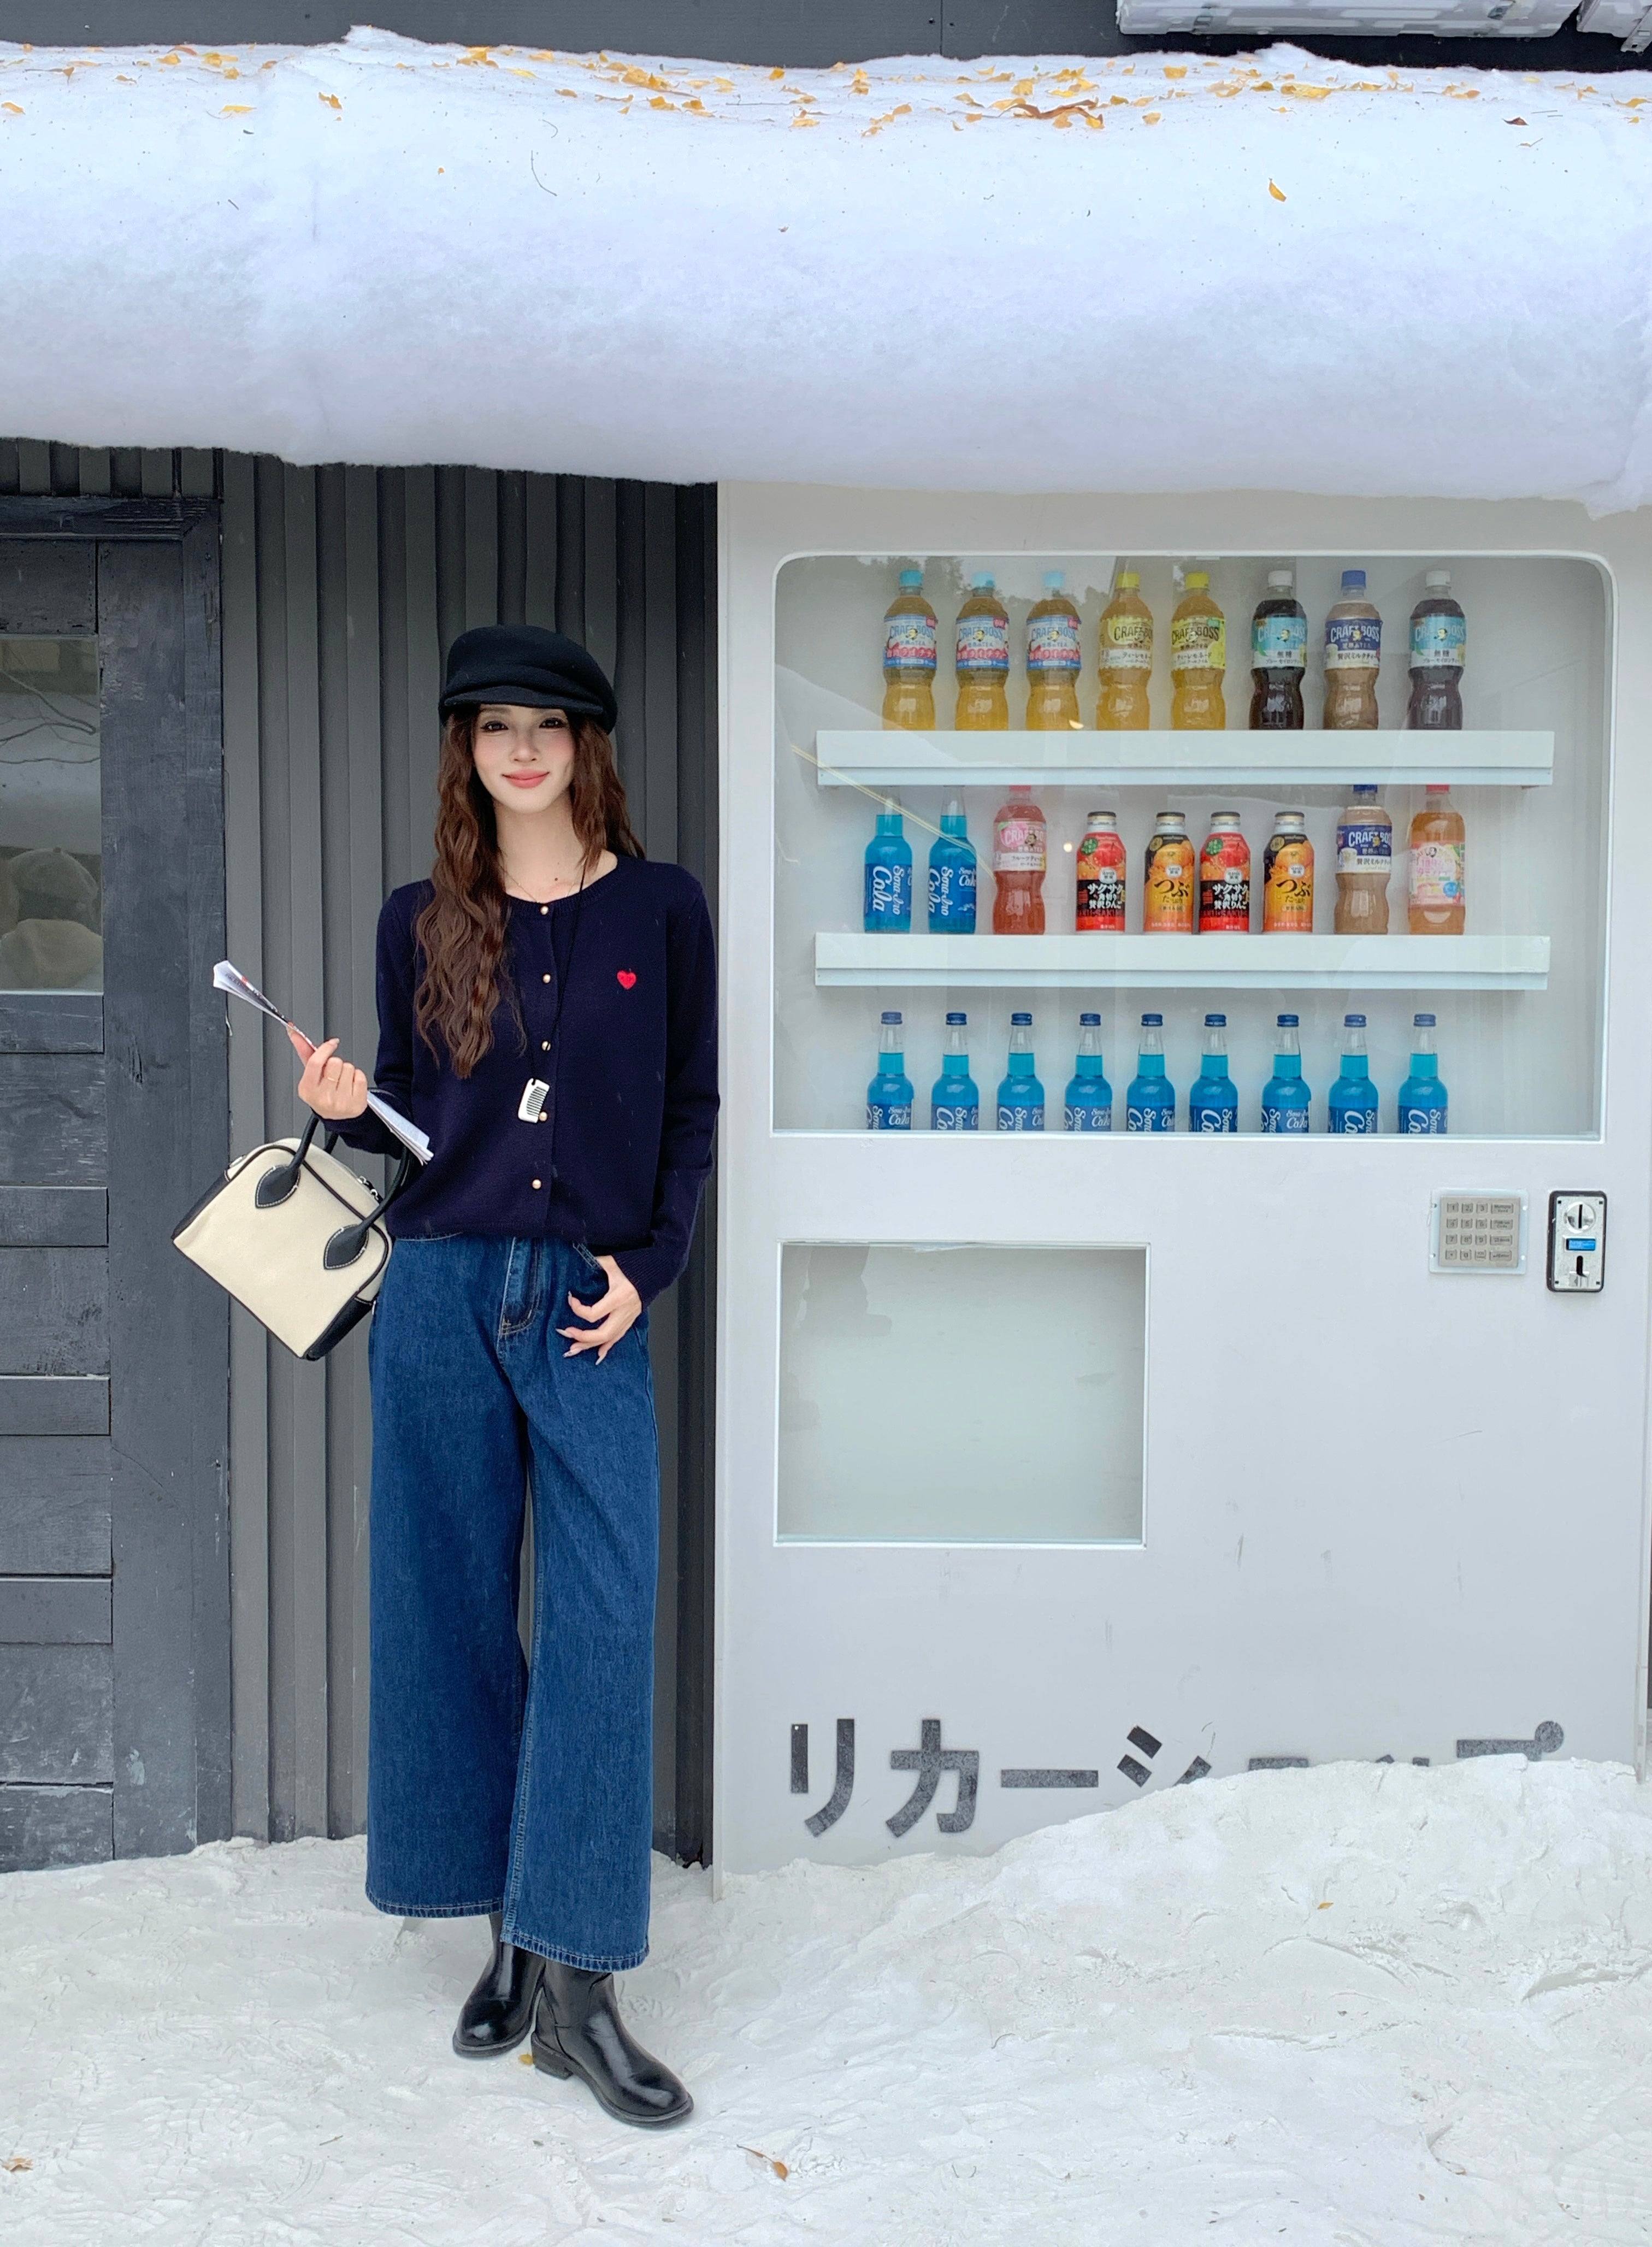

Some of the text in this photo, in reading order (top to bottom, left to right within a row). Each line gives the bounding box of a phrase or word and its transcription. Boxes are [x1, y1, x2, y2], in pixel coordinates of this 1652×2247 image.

[1196, 626, 1219, 641] BOSS
[1360, 625, 1379, 642] BOSS
[872, 866, 893, 912] Cola
[1087, 882, 1123, 895] サクサク
[1154, 878, 1190, 898] つぶ
[1212, 883, 1248, 895] サクサク
[1276, 878, 1311, 898] つぶ
[888, 1114, 910, 1125] Cola
[1286, 1117, 1308, 1129] Cola
